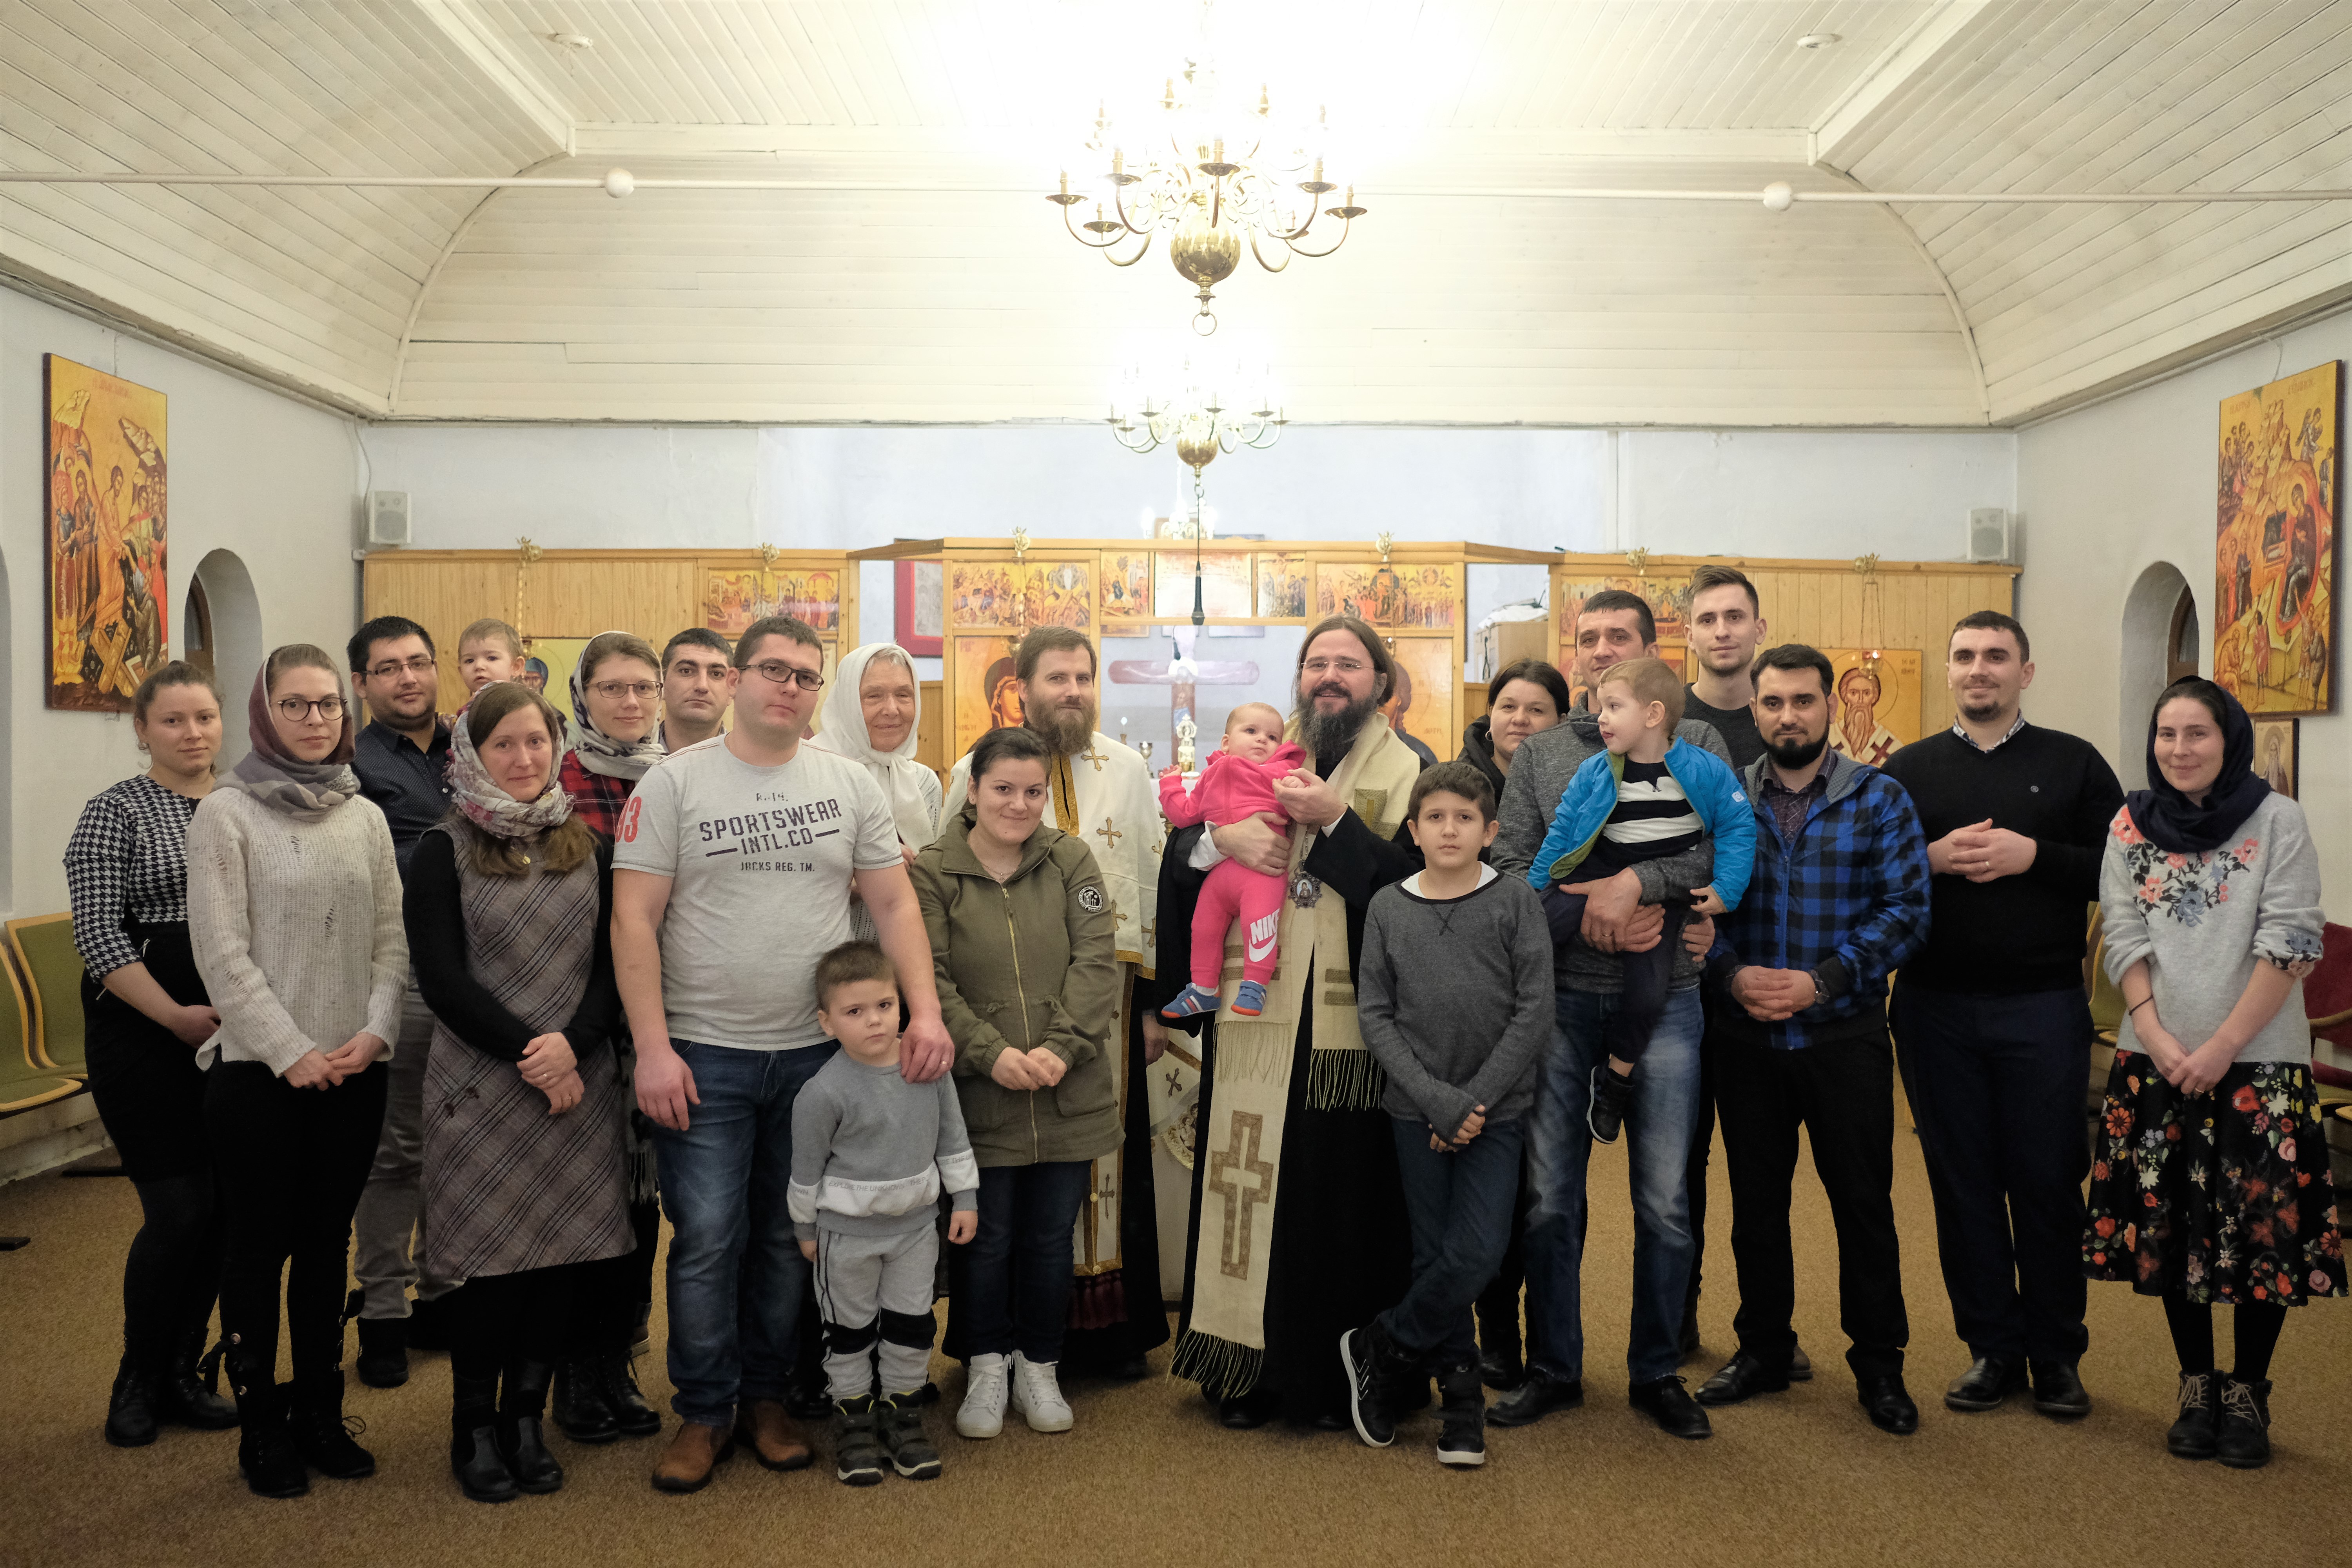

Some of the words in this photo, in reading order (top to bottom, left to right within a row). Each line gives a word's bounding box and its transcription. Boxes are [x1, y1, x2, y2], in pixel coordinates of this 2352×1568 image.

[699, 799, 842, 842] SPORTSWEAR
[741, 862, 771, 871] JACKS
[775, 862, 796, 871] REG.
[800, 863, 815, 872] TM.
